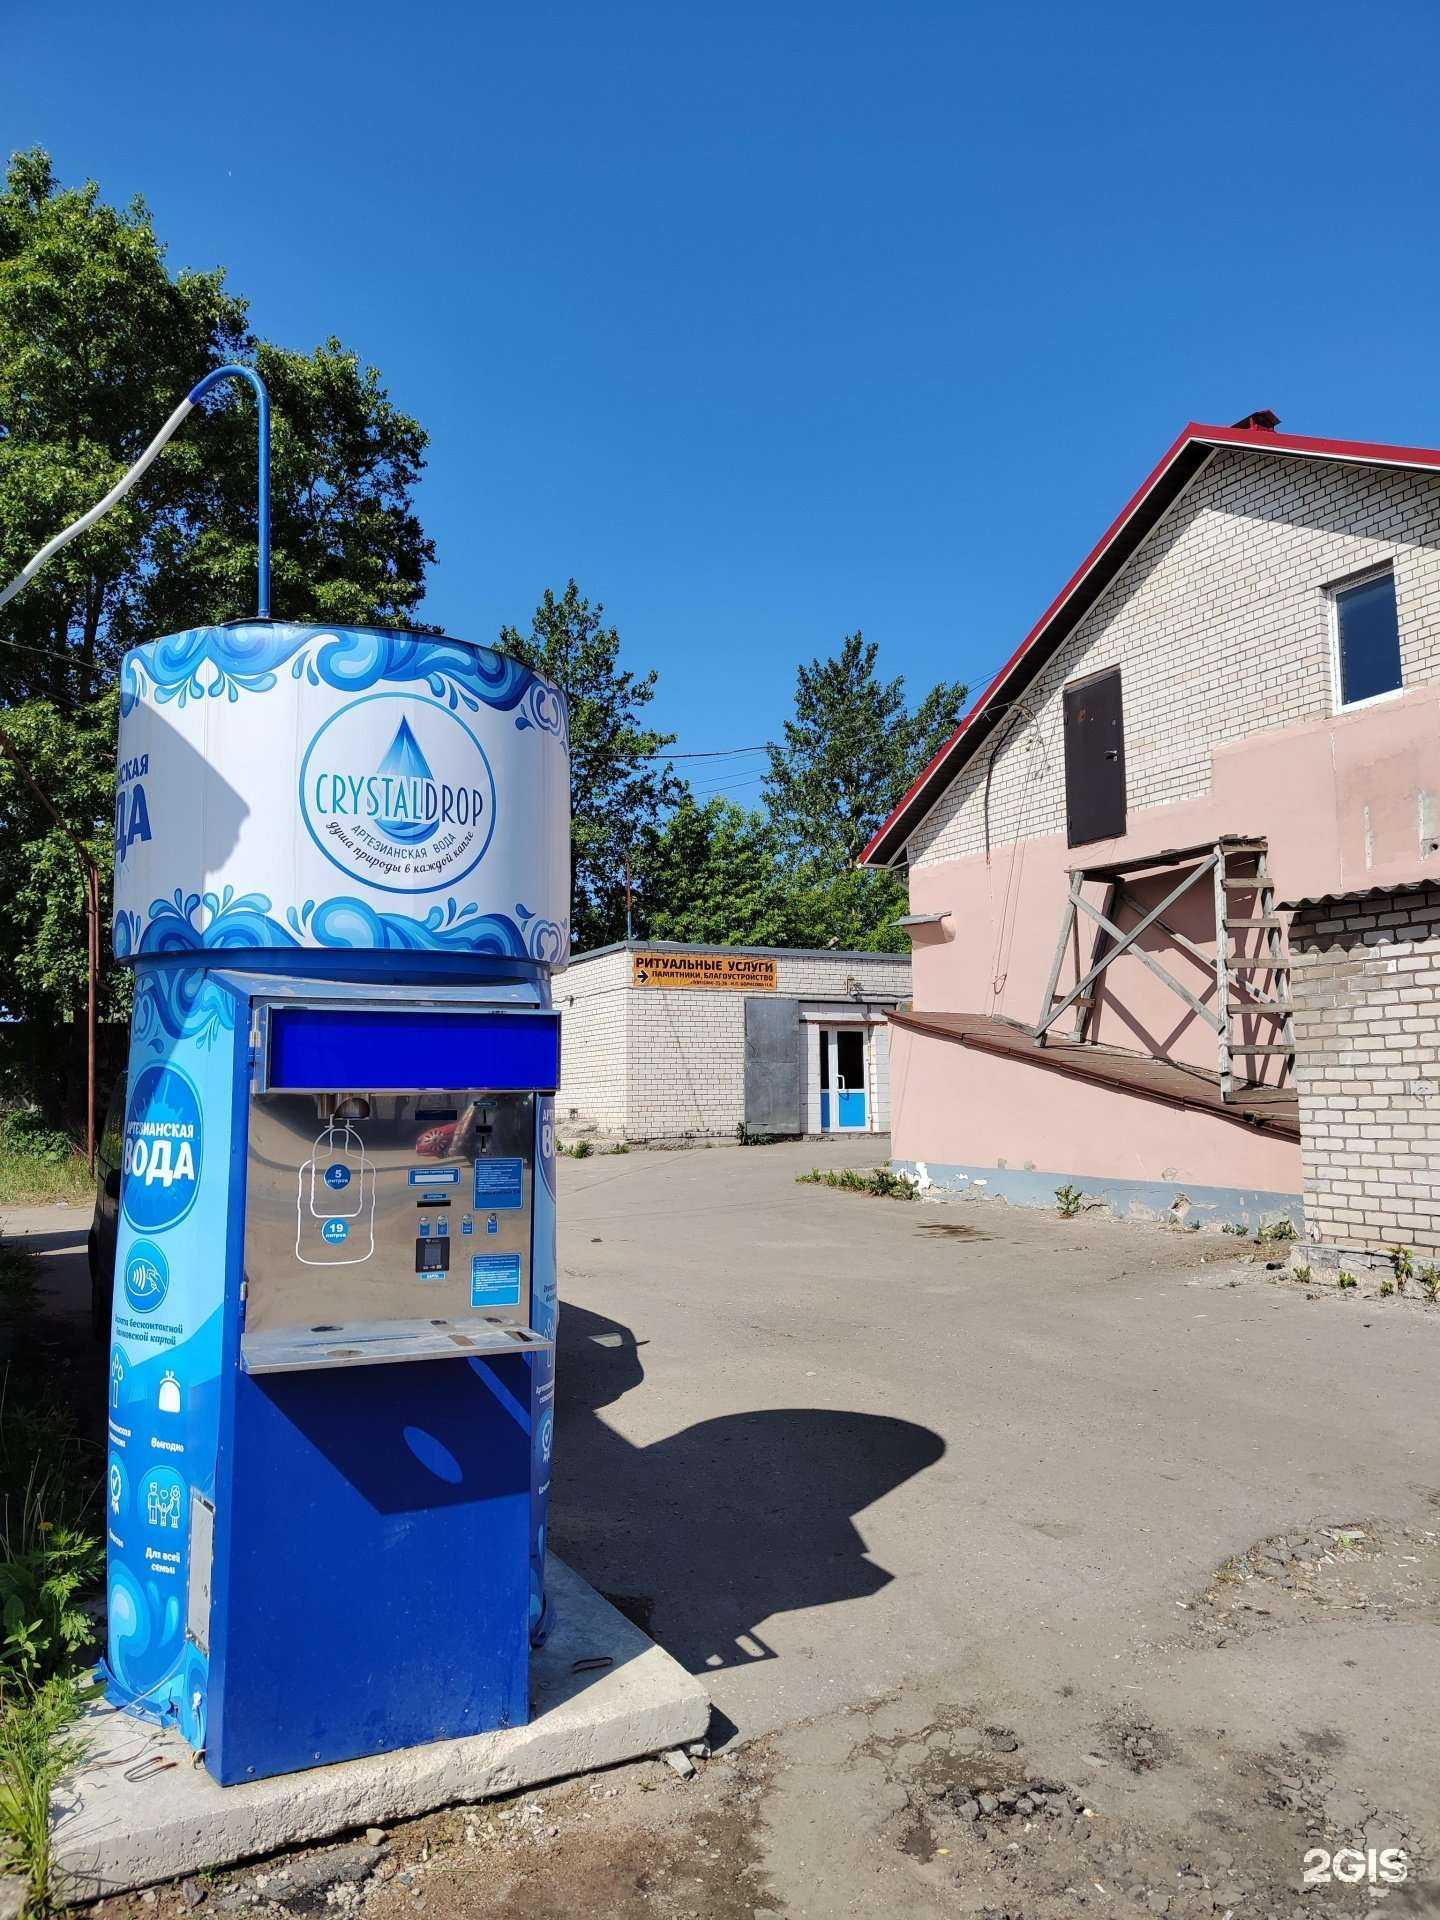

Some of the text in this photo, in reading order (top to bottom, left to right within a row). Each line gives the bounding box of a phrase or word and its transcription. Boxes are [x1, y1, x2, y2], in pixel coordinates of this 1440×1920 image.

[325, 821, 353, 849] душа
[353, 846, 401, 875] природы
[413, 854, 453, 874] каждой
[453, 831, 474, 859] капле
[351, 825, 457, 859] АРТЕЗИАНСКАЯ ВОДА
[636, 957, 773, 973] РИТУАЛЬНЫЕ УСЛУГИ
[704, 972, 773, 981] БЛАГОУСТРОЙСТВО
[124, 1138, 195, 1188] ВОДА
[335, 1169, 342, 1178] 5
[329, 1223, 344, 1233] 19
[151, 1437, 184, 1453] Выгодно
[145, 1546, 180, 1563] Для всей
[151, 1563, 176, 1575] семьи
